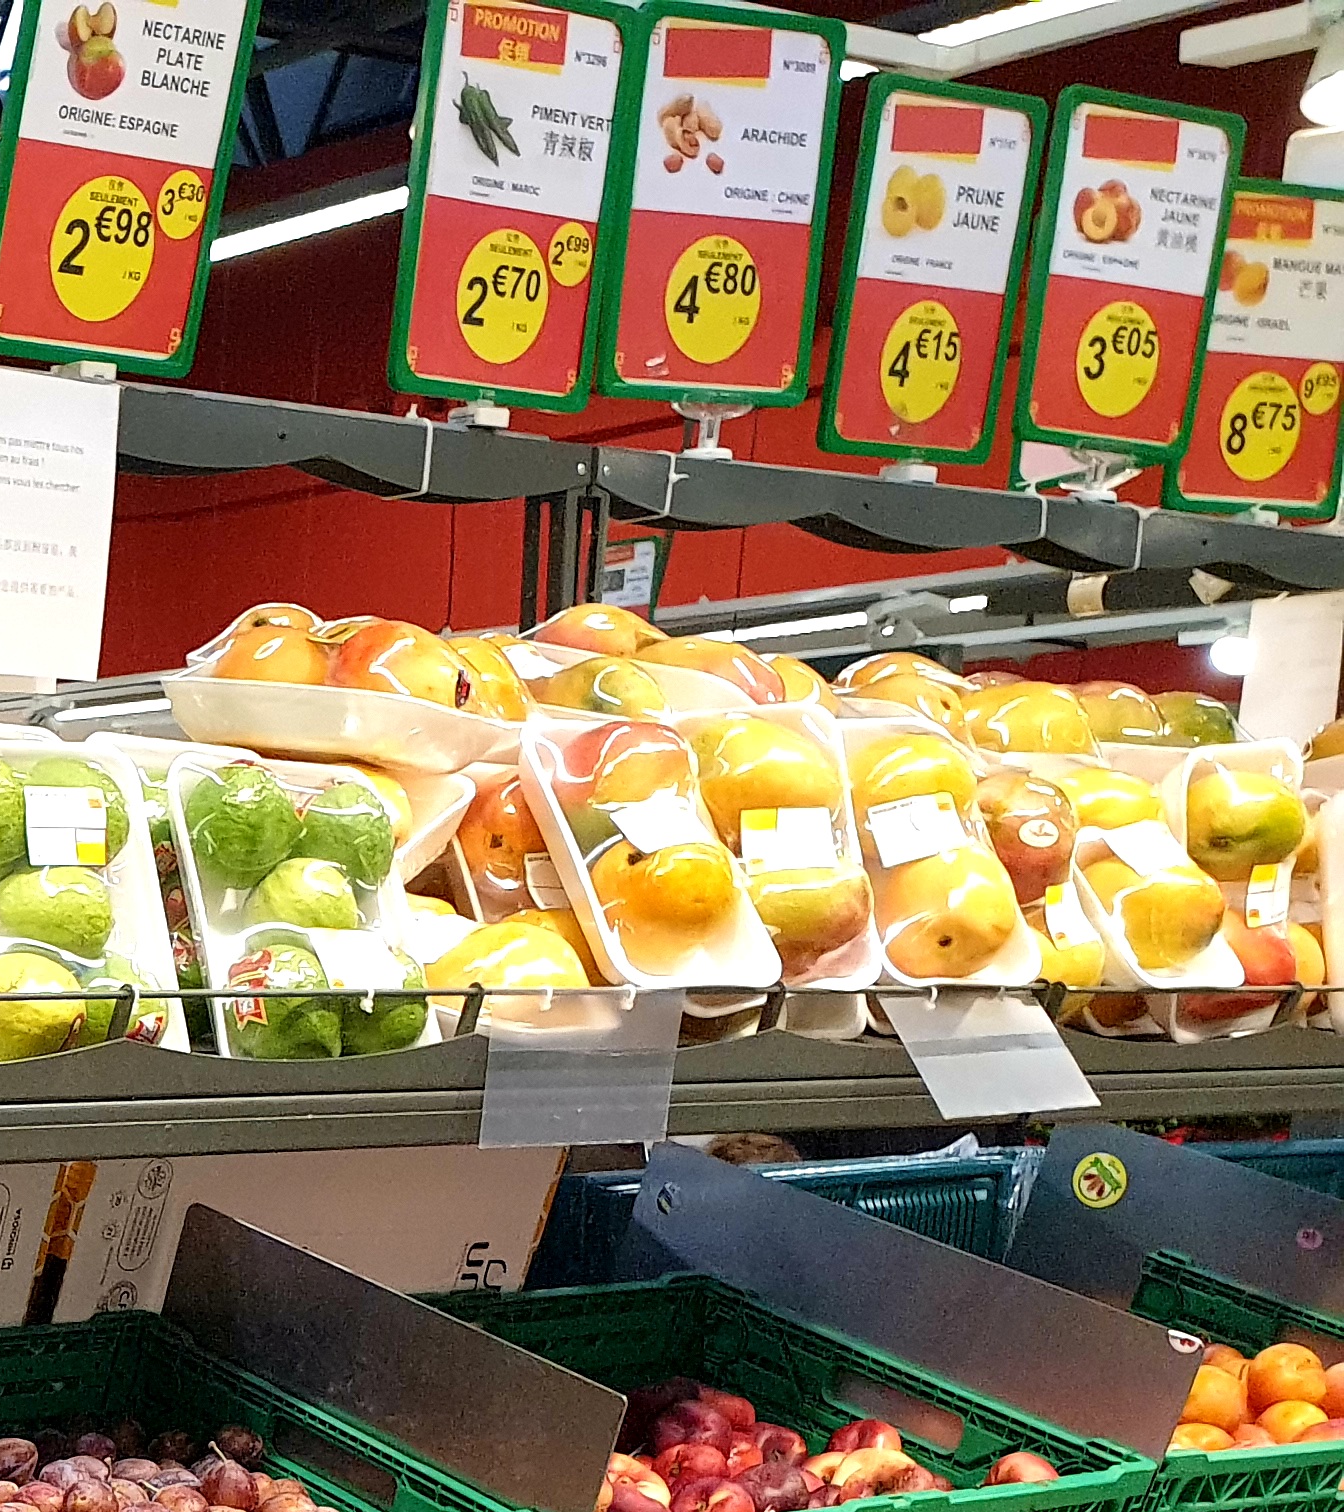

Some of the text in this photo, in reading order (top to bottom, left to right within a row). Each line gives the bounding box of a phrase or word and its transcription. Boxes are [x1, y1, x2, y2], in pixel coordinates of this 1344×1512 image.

[142, 19, 226, 50] NECTARINE
[474, 8, 561, 42] PROMOTION
[156, 48, 205, 71] PLATE
[141, 70, 211, 98] BLANCHE
[118, 115, 179, 139] ESPAGNE
[531, 105, 613, 132] PIMENT VERT
[741, 128, 808, 147] ARACHIDE
[89, 191, 138, 207] SEULEMENT
[723, 186, 769, 202] ORIGINE
[955, 185, 1006, 208] PRUNE
[952, 211, 1000, 233] JAUNE
[57, 206, 153, 276] 2€98
[462, 264, 542, 327] 2€70
[673, 261, 757, 324] 4€80
[888, 328, 960, 388] 4€15
[1083, 325, 1158, 381] 3€05
[1226, 401, 1297, 455] 8€75
